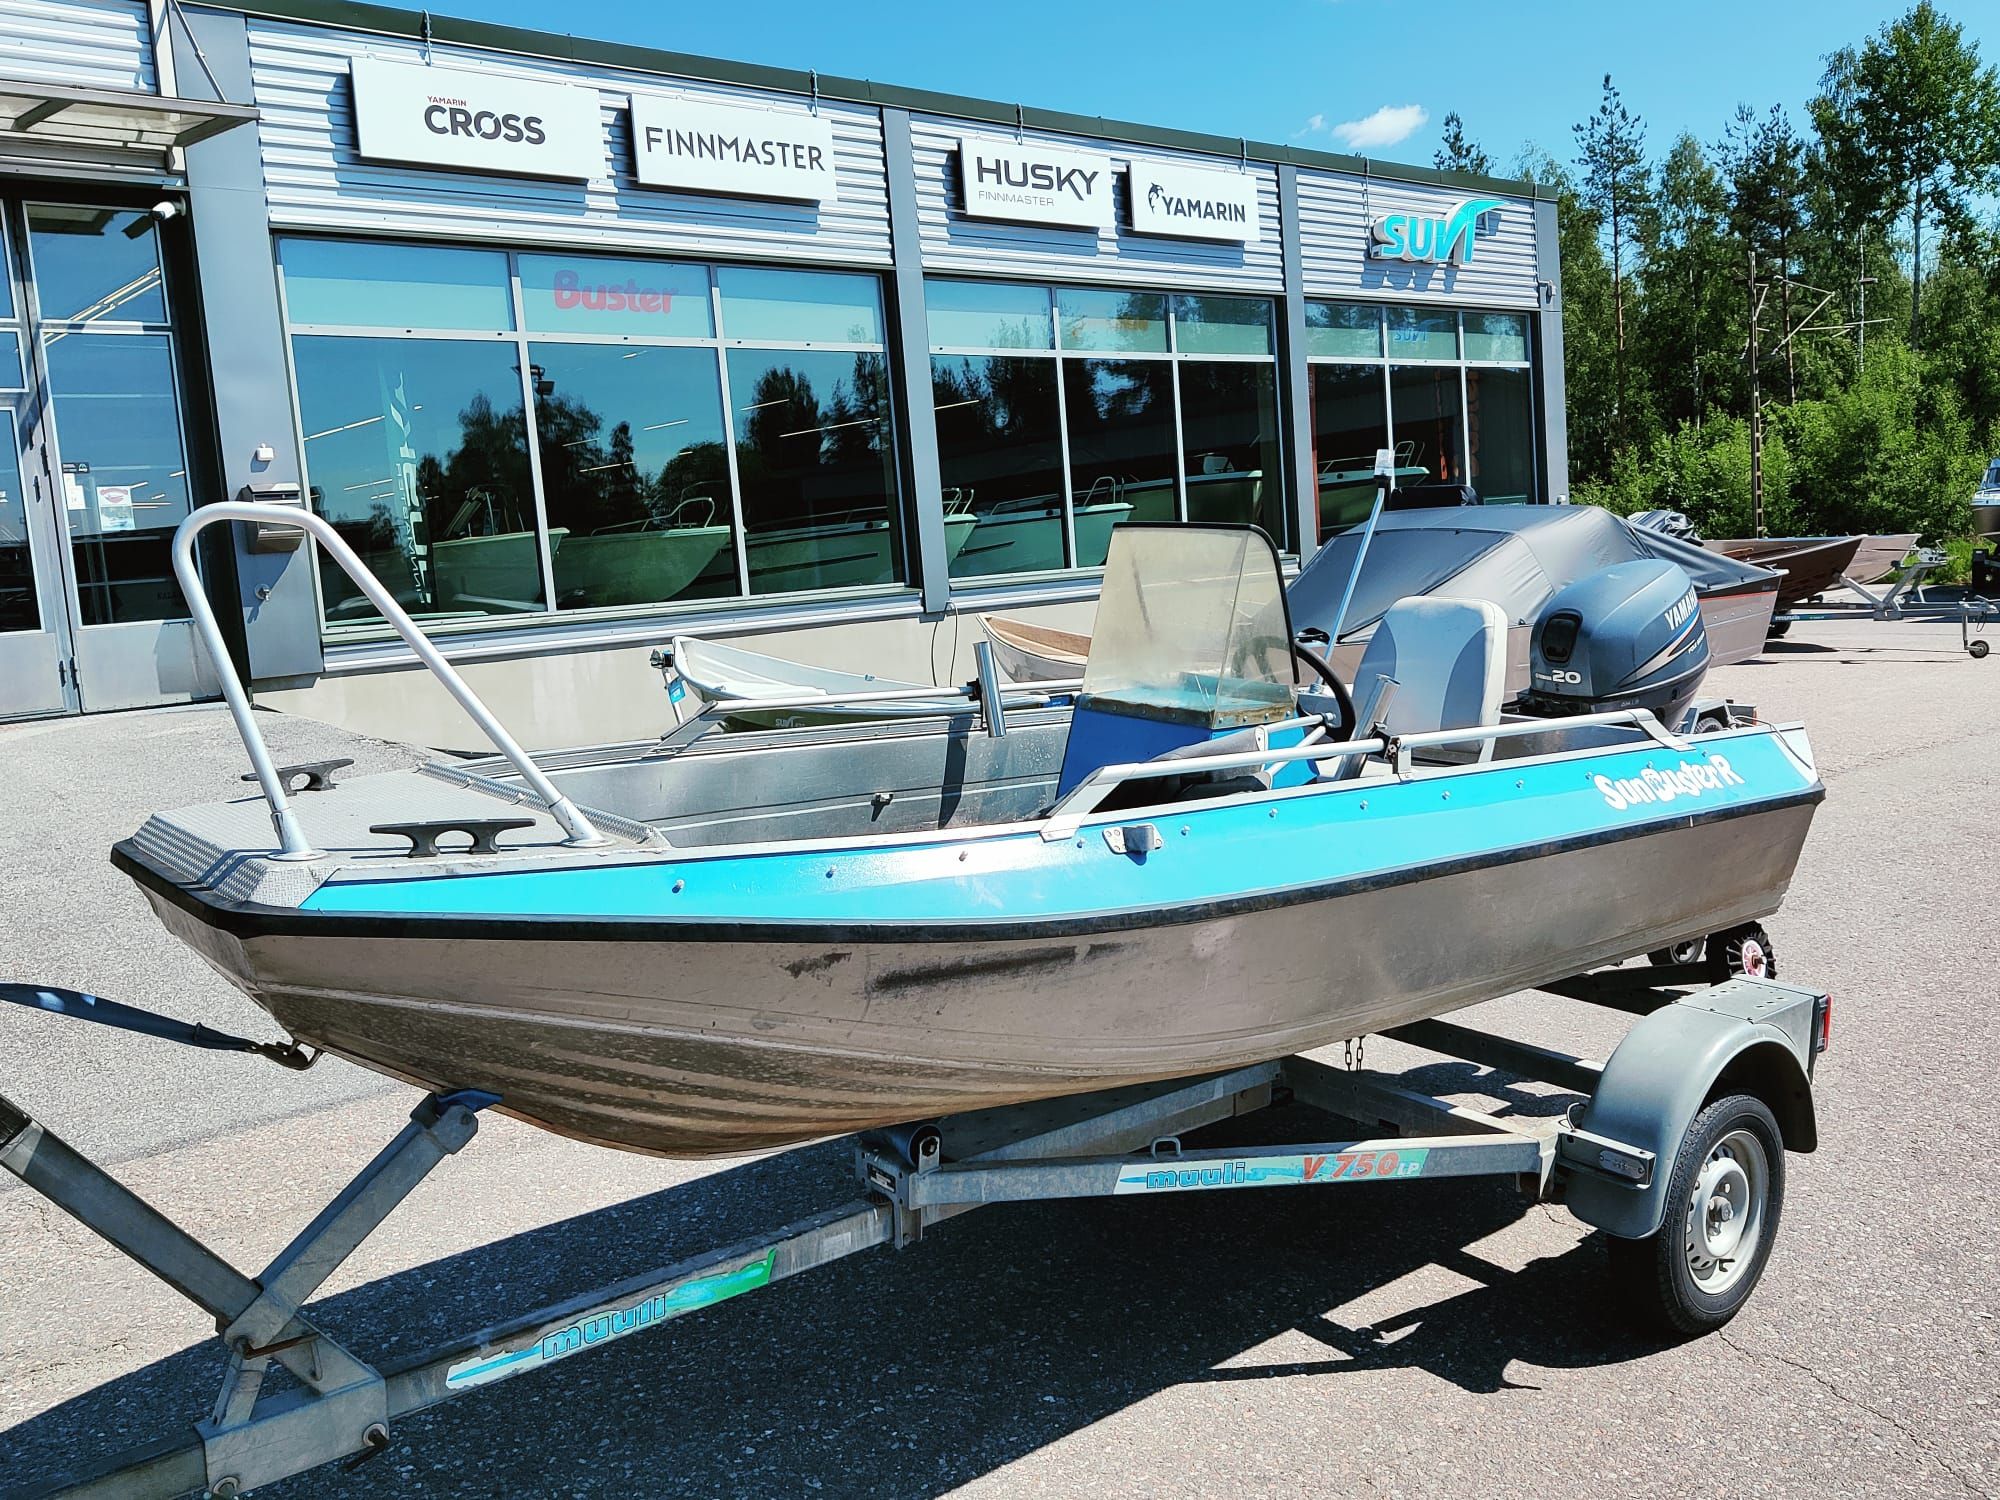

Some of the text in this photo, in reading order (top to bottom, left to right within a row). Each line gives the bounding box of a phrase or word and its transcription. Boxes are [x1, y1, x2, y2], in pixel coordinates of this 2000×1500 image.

[427, 95, 467, 106] YAMARIN
[424, 105, 546, 145] CROSS
[645, 126, 826, 171] FINNMASTER
[976, 157, 1099, 201] HUSKY
[978, 190, 1054, 206] FINNMASTER
[1162, 196, 1246, 223] YAMARIN
[554, 269, 680, 314] Buster
[1664, 585, 1698, 631] YAMAH
[1551, 670, 1582, 684] 20
[1147, 1152, 1424, 1189] muuli V 750 LP
[543, 1294, 665, 1360] muuli
